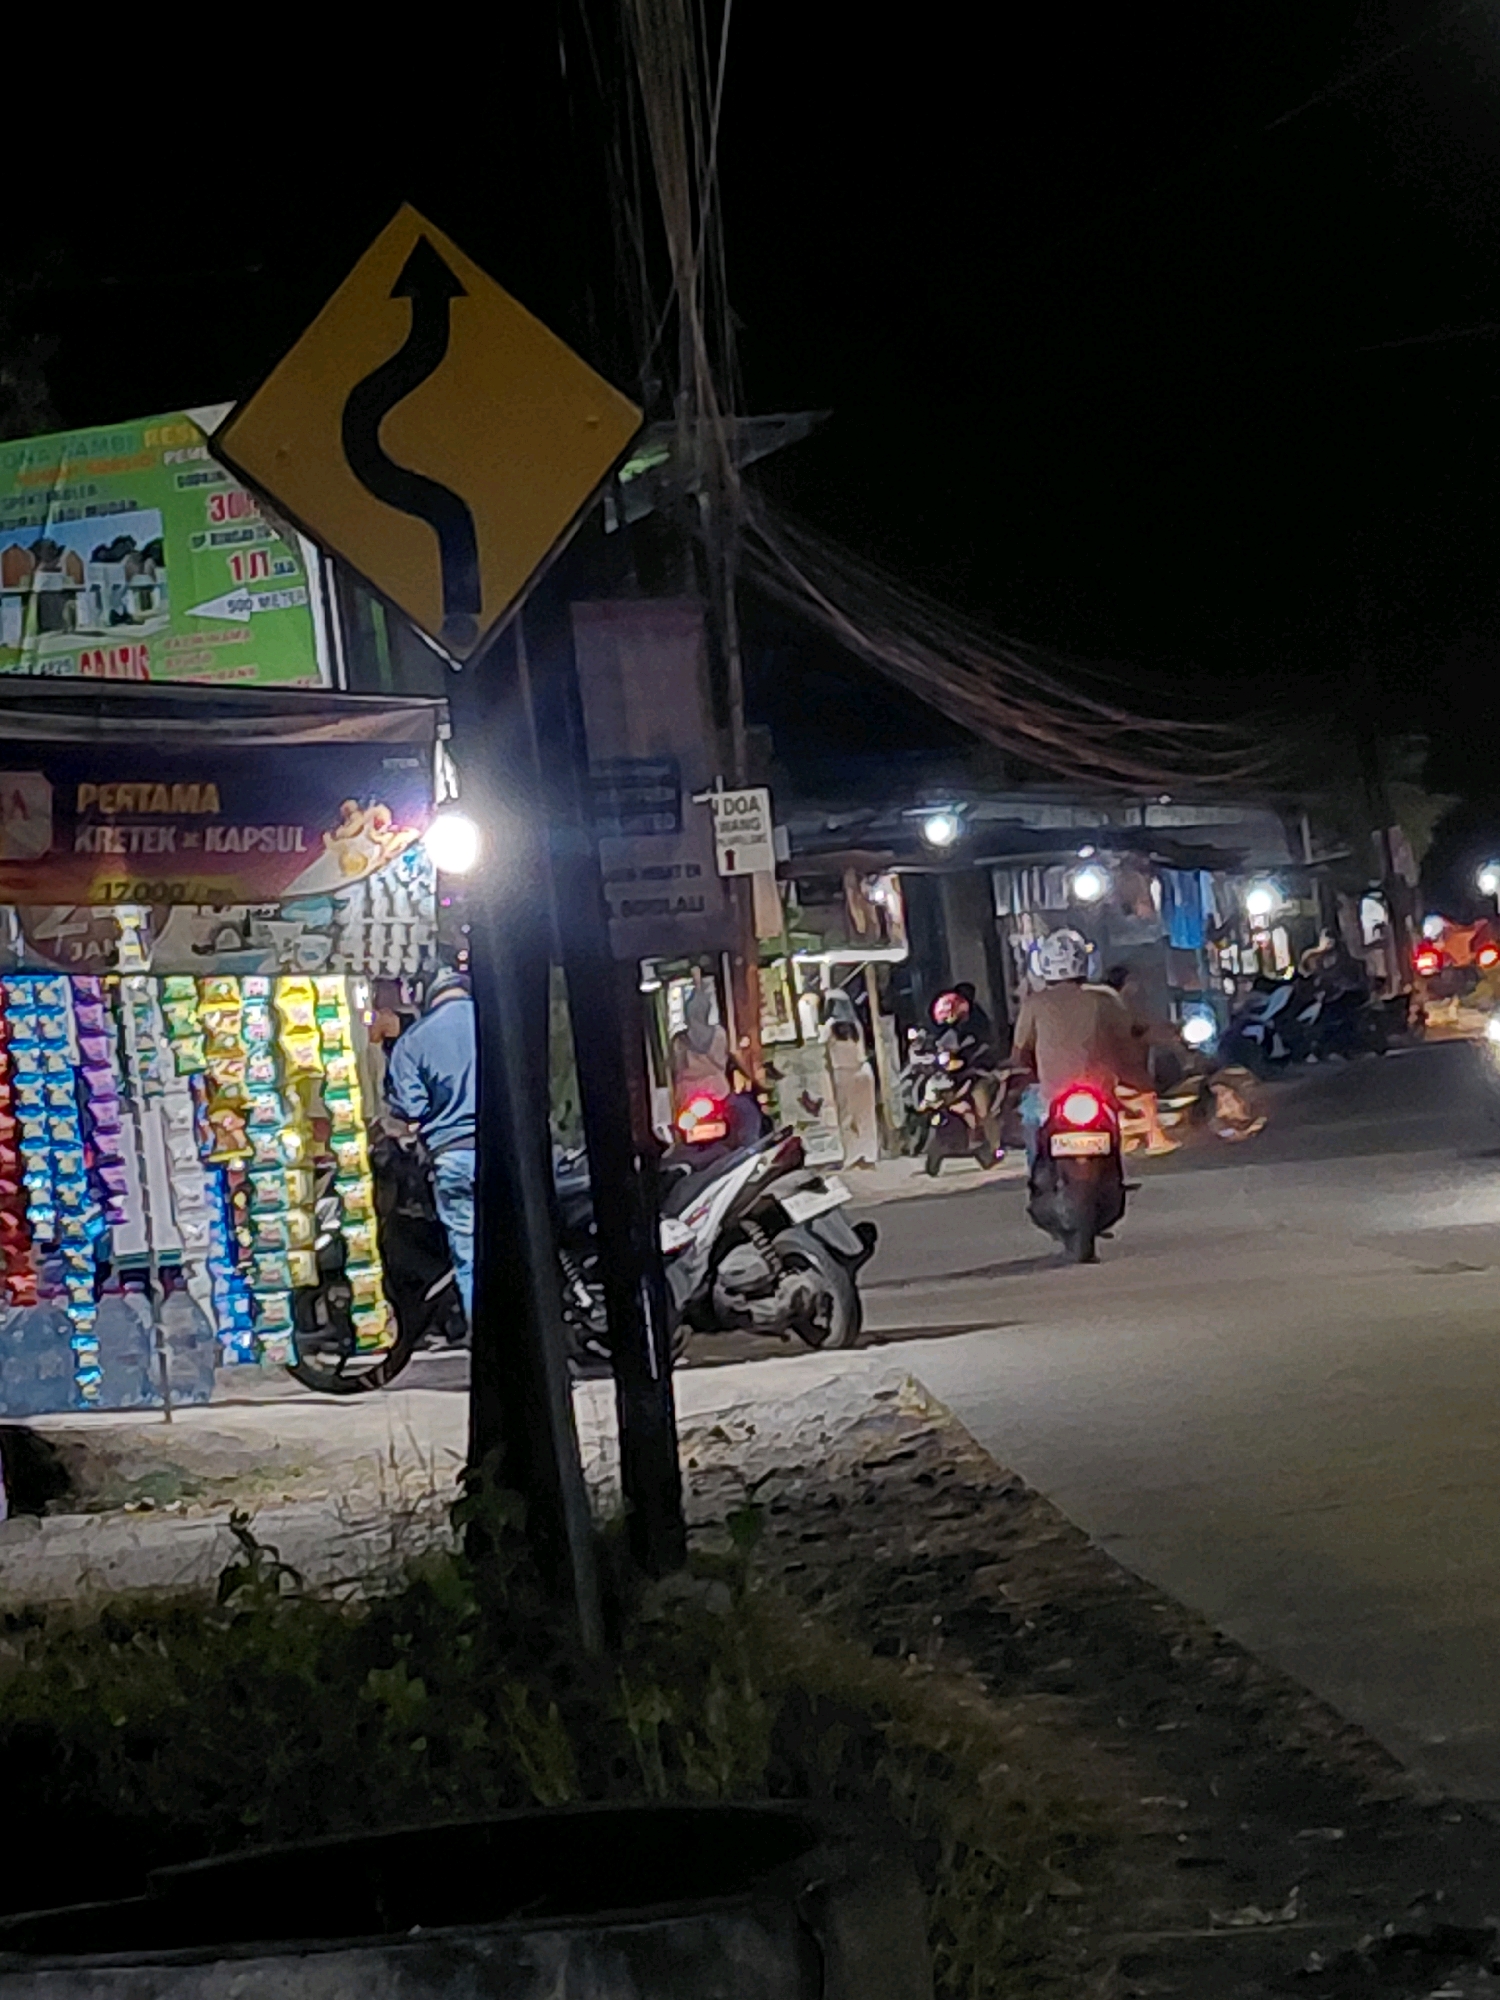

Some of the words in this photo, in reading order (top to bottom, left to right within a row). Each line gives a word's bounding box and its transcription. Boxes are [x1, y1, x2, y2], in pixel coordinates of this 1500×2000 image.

[76, 782, 220, 814] PERTAMA
[724, 796, 761, 815] DOA
[74, 825, 177, 854] KRETEK
[204, 824, 308, 853] KAPSUL
